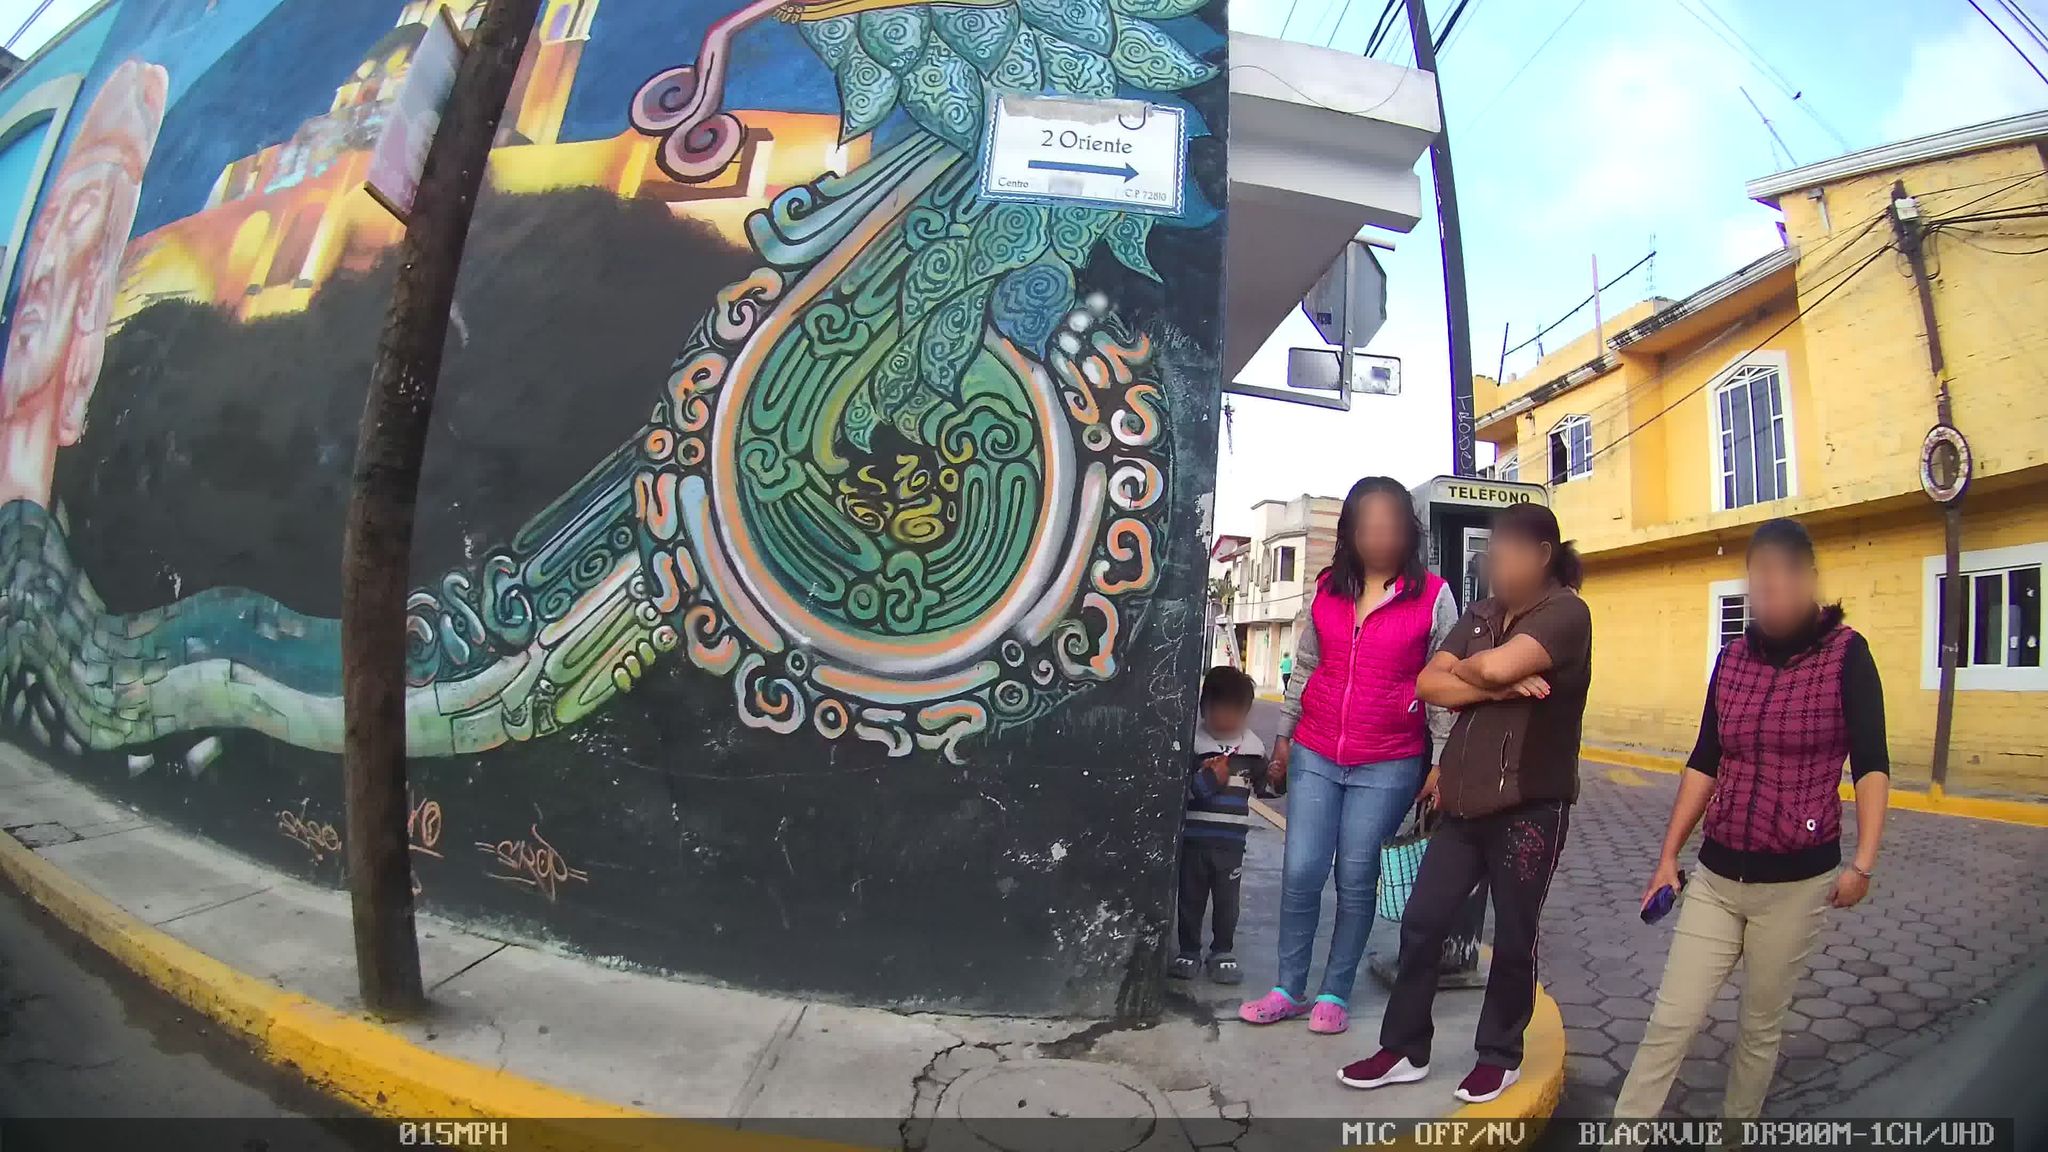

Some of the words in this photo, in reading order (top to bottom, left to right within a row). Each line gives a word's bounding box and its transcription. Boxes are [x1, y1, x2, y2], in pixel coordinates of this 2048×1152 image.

[1041, 129, 1053, 147] 2
[1060, 130, 1133, 154] Oriente
[998, 176, 1029, 188] Centro
